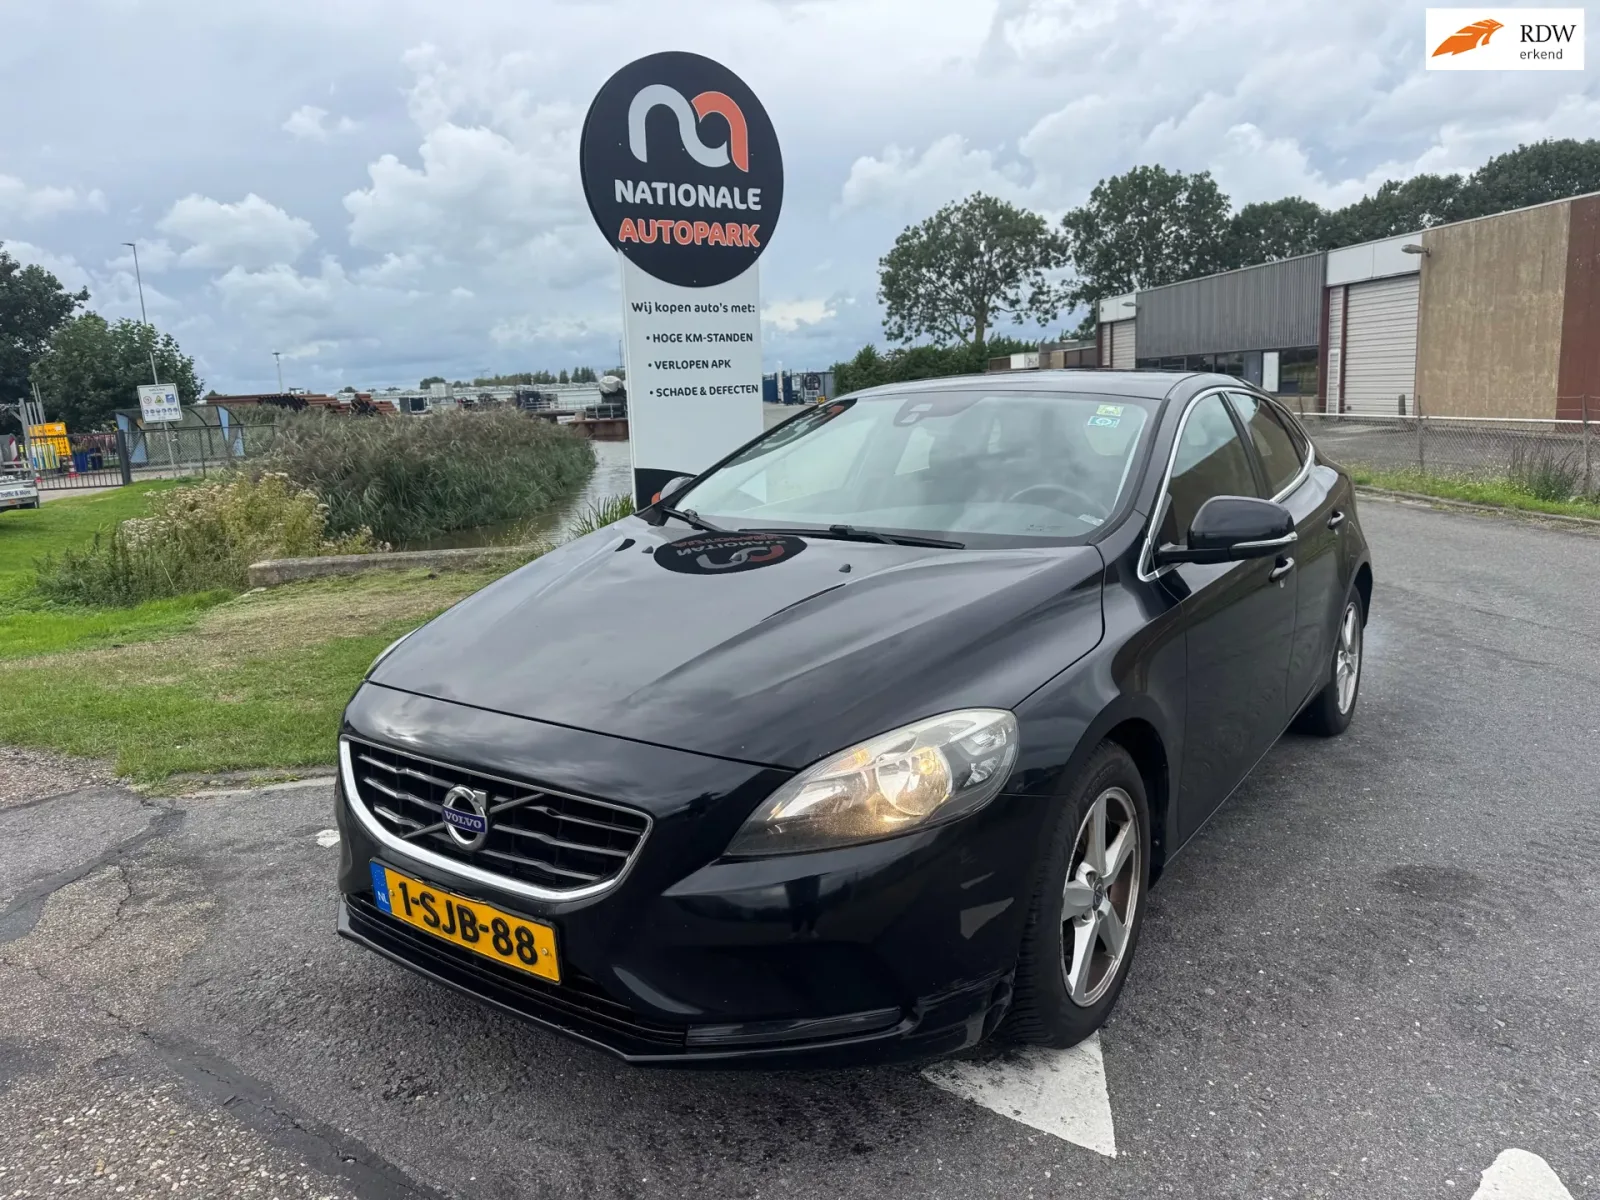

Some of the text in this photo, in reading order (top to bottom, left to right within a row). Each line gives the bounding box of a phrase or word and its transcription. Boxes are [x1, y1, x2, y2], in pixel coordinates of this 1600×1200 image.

[614, 179, 762, 211] NATIONALE
[618, 217, 761, 248] AUTOPARK
[631, 301, 756, 315] Wij kopen auto's met:
[653, 333, 754, 343] HOGE KM-STANDEN
[654, 359, 732, 370] VERLOPEN APK
[656, 384, 759, 397] SCHADE & DEFECTEN
[444, 810, 482, 829] VOLVO
[377, 890, 389, 905] NL
[398, 881, 538, 966] 1-SJB-88
